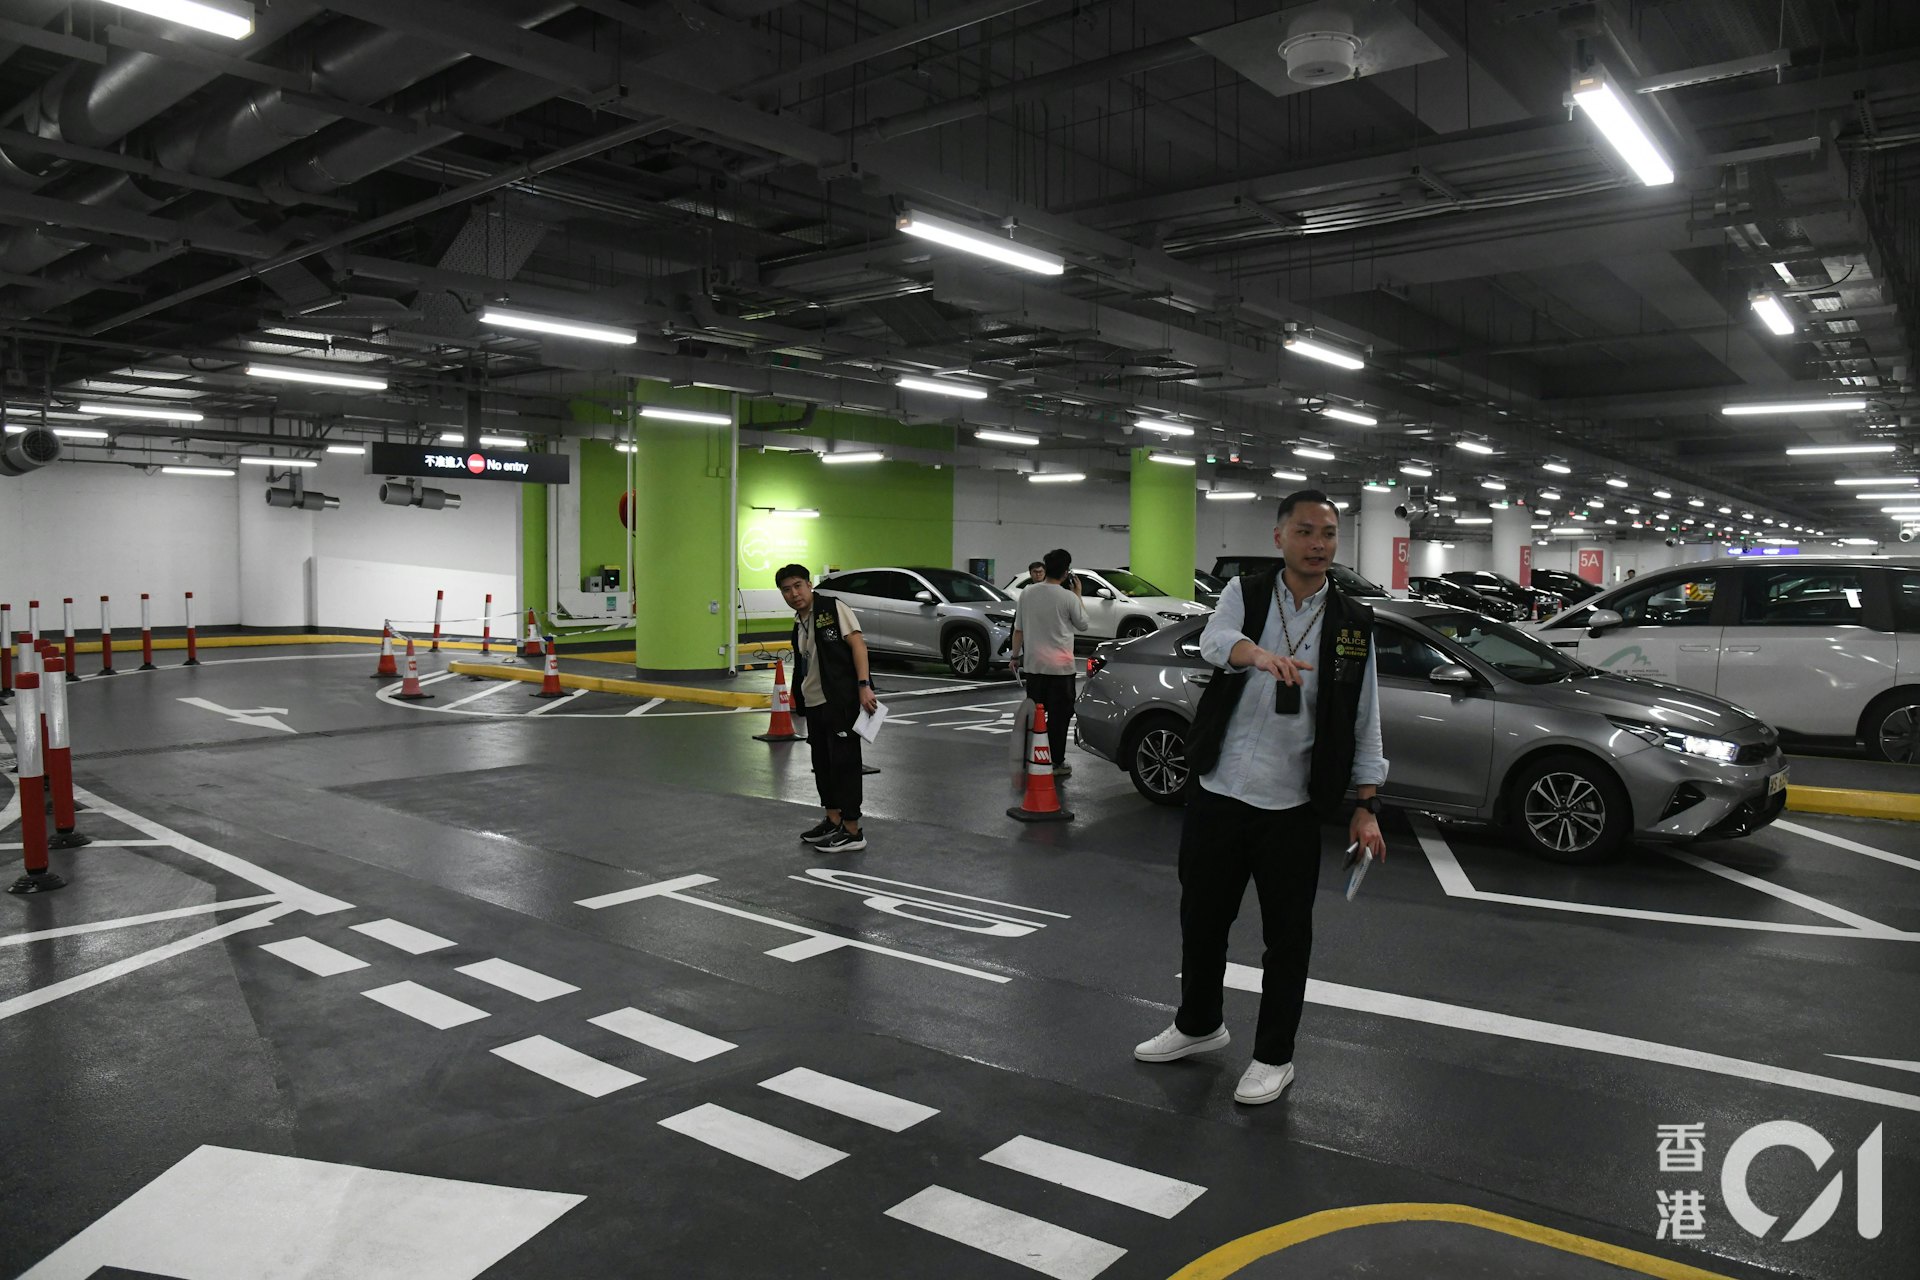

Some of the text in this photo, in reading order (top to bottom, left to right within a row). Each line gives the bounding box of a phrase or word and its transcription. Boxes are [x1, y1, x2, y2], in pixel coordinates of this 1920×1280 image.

[487, 459, 529, 474] No entry
[1580, 553, 1600, 567] 5A
[1336, 636, 1366, 646] POLICE
[788, 868, 1072, 937] UP
